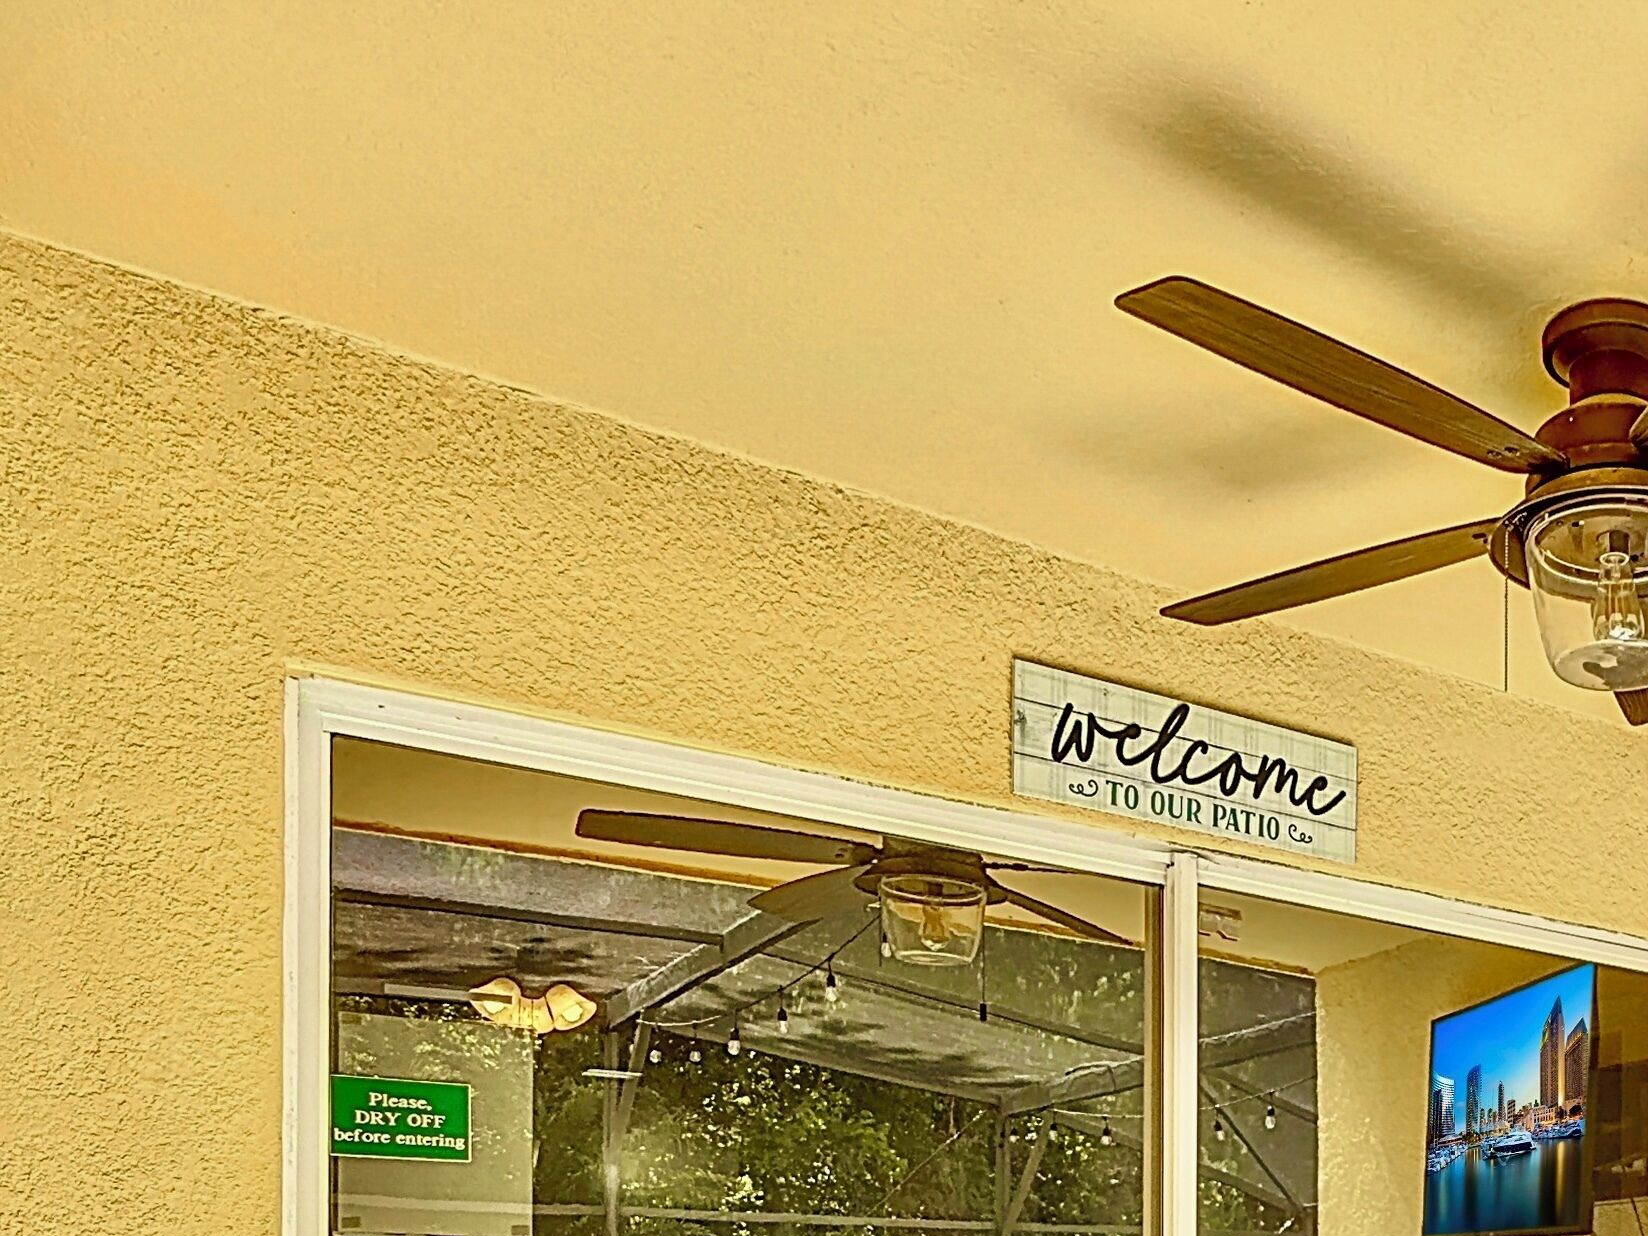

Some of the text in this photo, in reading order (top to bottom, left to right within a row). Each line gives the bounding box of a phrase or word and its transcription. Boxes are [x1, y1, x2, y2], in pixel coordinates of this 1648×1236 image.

[1051, 703, 1347, 816] welcome
[1105, 779, 1280, 841] TO OUR PATIO
[333, 1128, 466, 1151] before entering
[354, 1110, 446, 1129] DRY OFF
